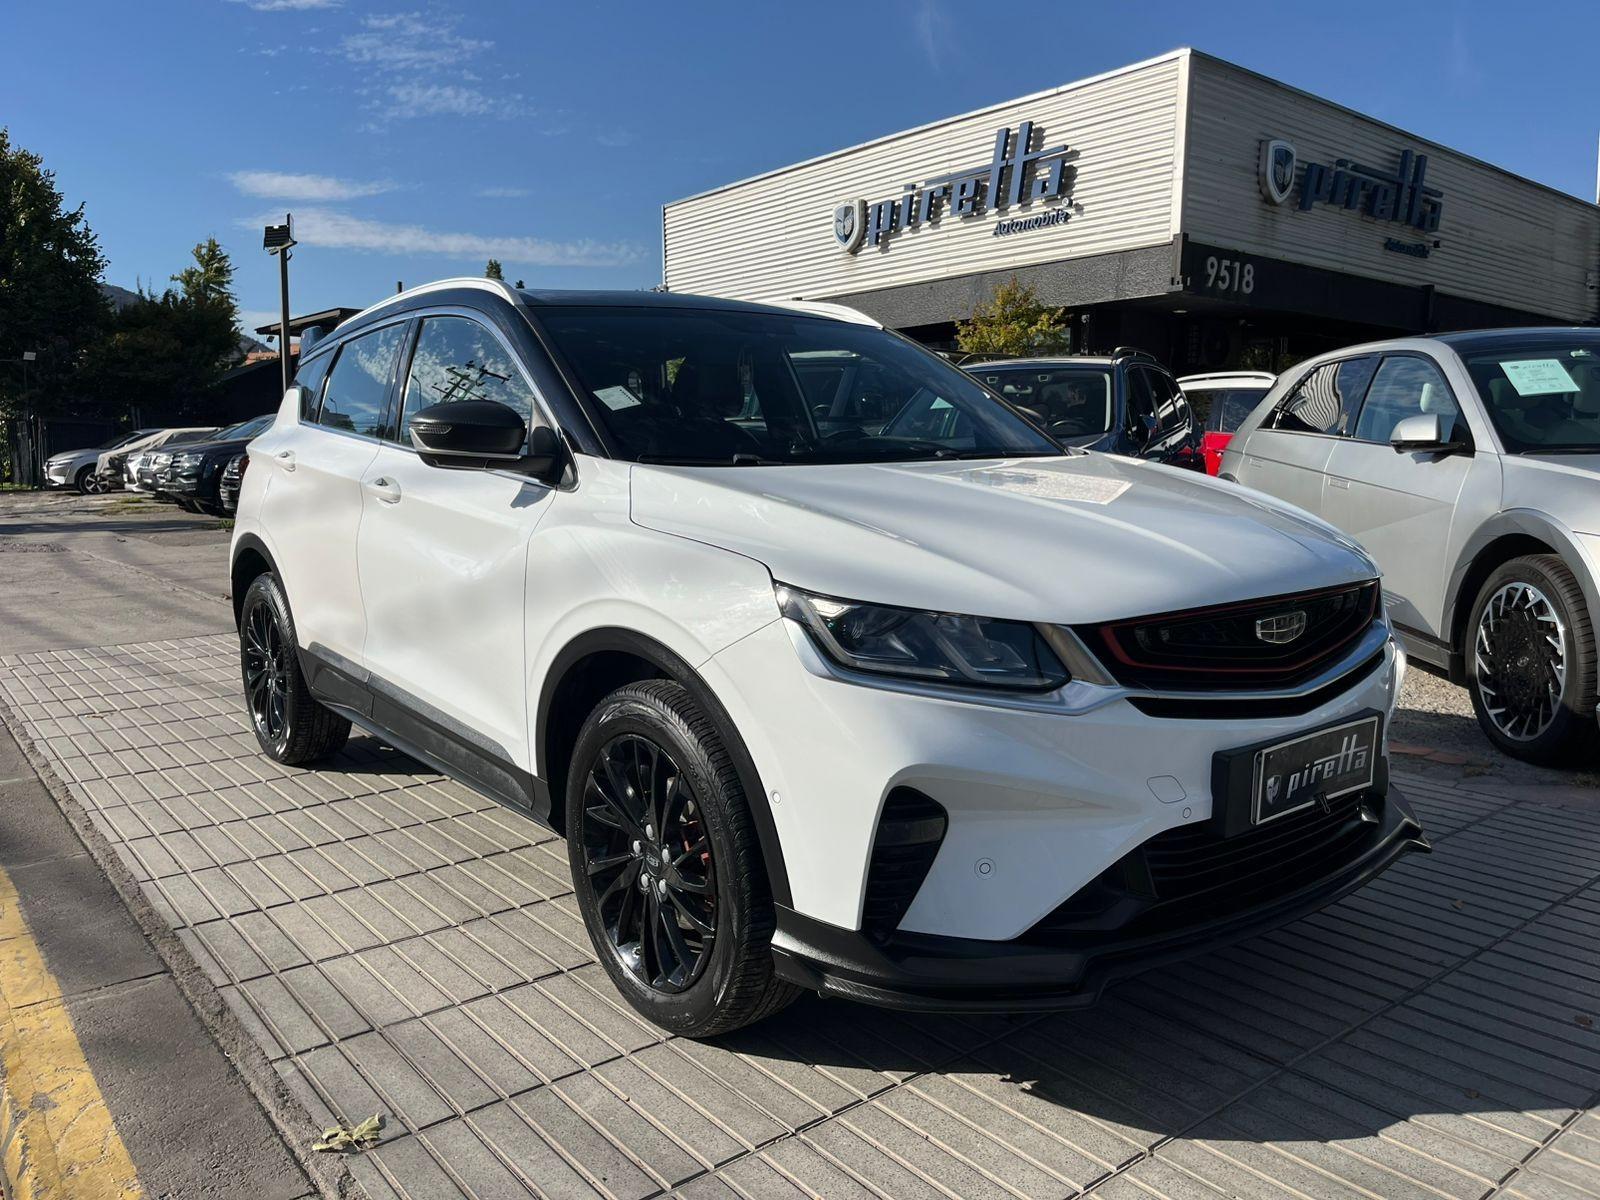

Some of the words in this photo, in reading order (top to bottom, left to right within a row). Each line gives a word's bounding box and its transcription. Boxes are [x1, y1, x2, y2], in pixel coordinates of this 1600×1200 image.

[867, 121, 1069, 247] piretta
[1298, 149, 1444, 233] piretta
[1205, 255, 1255, 295] 9518
[1286, 733, 1369, 799] piretta
